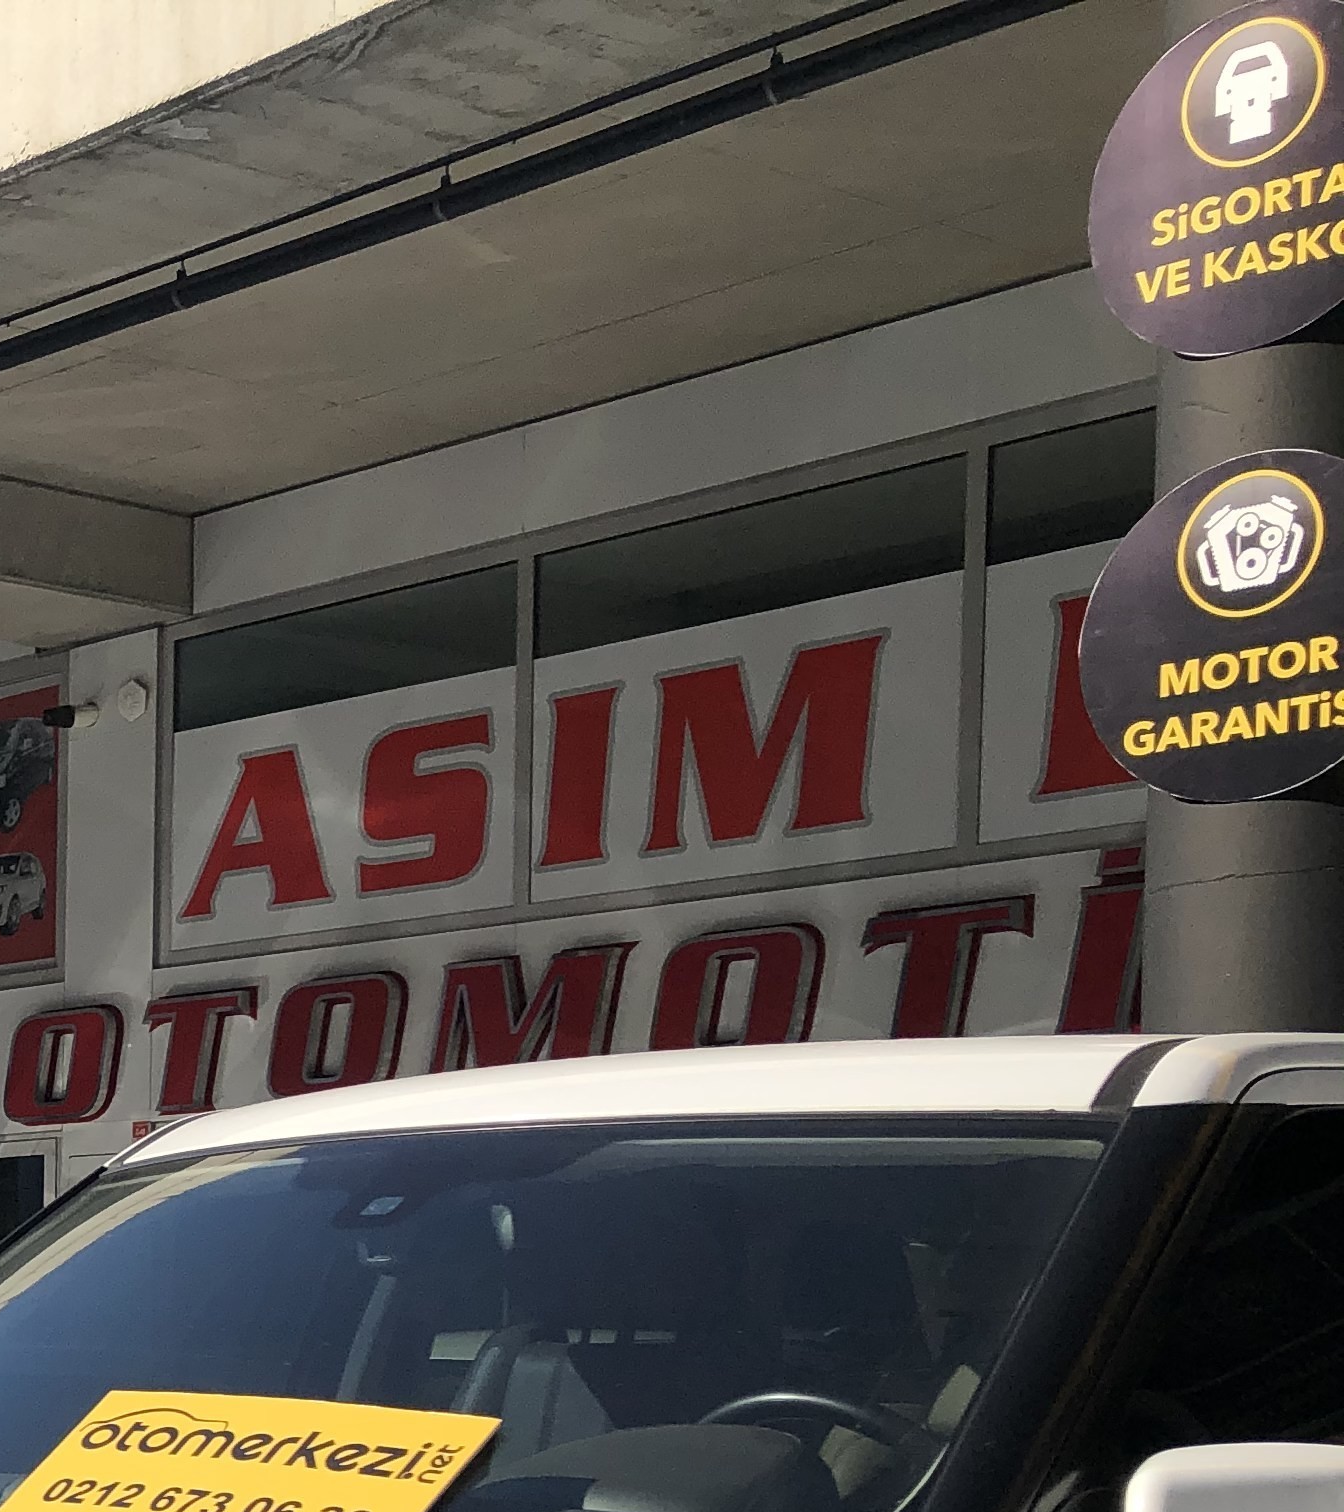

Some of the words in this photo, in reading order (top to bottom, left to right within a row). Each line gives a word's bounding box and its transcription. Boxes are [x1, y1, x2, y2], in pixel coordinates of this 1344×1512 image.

[1136, 264, 1192, 304] VE
[1158, 636, 1338, 698] MOTOR
[178, 627, 890, 924] ASIM
[42, 1477, 144, 1509] 0212
